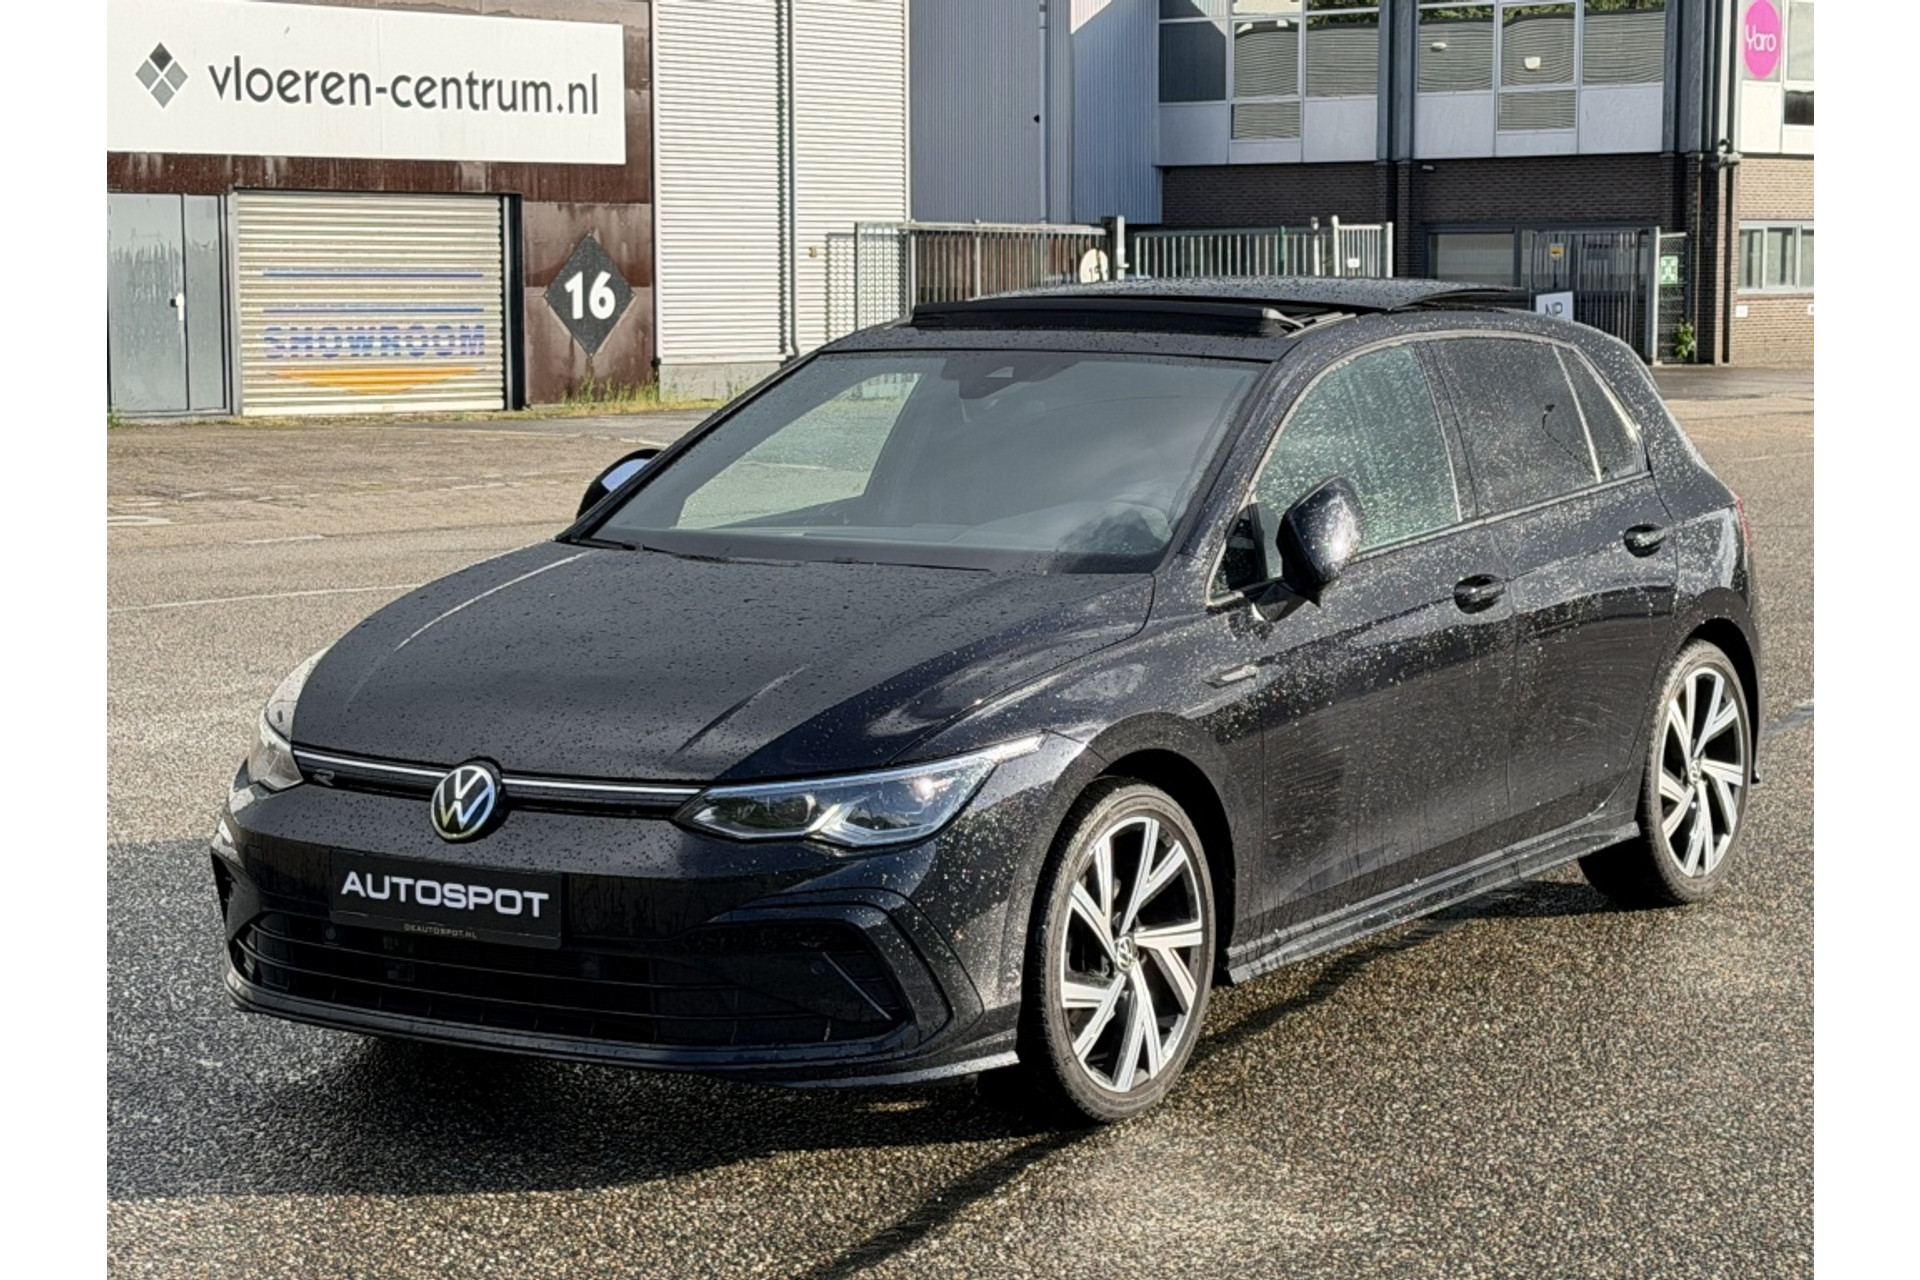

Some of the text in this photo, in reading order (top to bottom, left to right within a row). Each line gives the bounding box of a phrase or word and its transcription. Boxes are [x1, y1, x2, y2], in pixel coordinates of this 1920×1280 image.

[1745, 24, 1777, 52] Yaro
[208, 55, 599, 115] vloeren-centrum.nl
[564, 271, 616, 320] 16
[264, 324, 485, 359] SHOWROOM
[341, 871, 549, 918] AUTOSPOT
